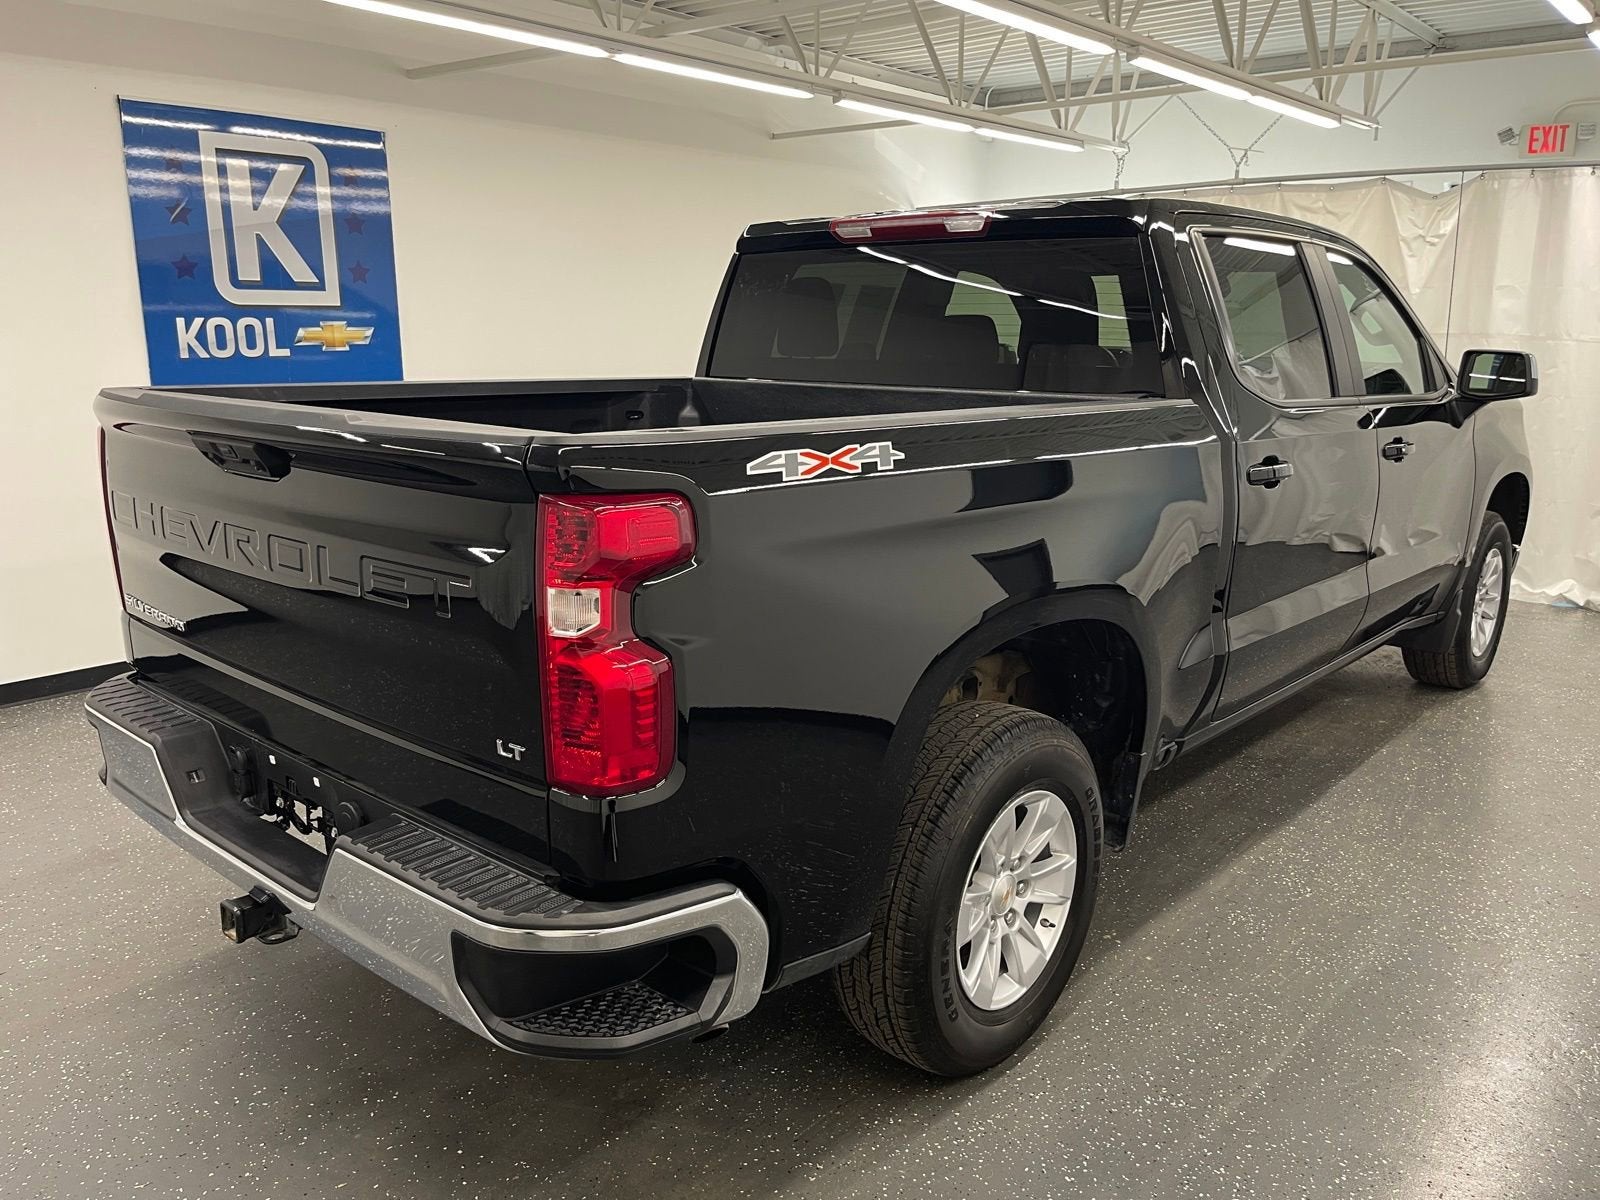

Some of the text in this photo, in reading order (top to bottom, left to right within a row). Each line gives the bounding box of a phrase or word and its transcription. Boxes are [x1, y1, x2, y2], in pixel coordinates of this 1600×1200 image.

[1528, 124, 1570, 154] EXIT
[225, 157, 319, 283] K
[176, 316, 290, 358] KOOL
[111, 489, 471, 618] CHEVROLET
[125, 593, 186, 632] SILVERADO
[496, 738, 526, 761] LT
